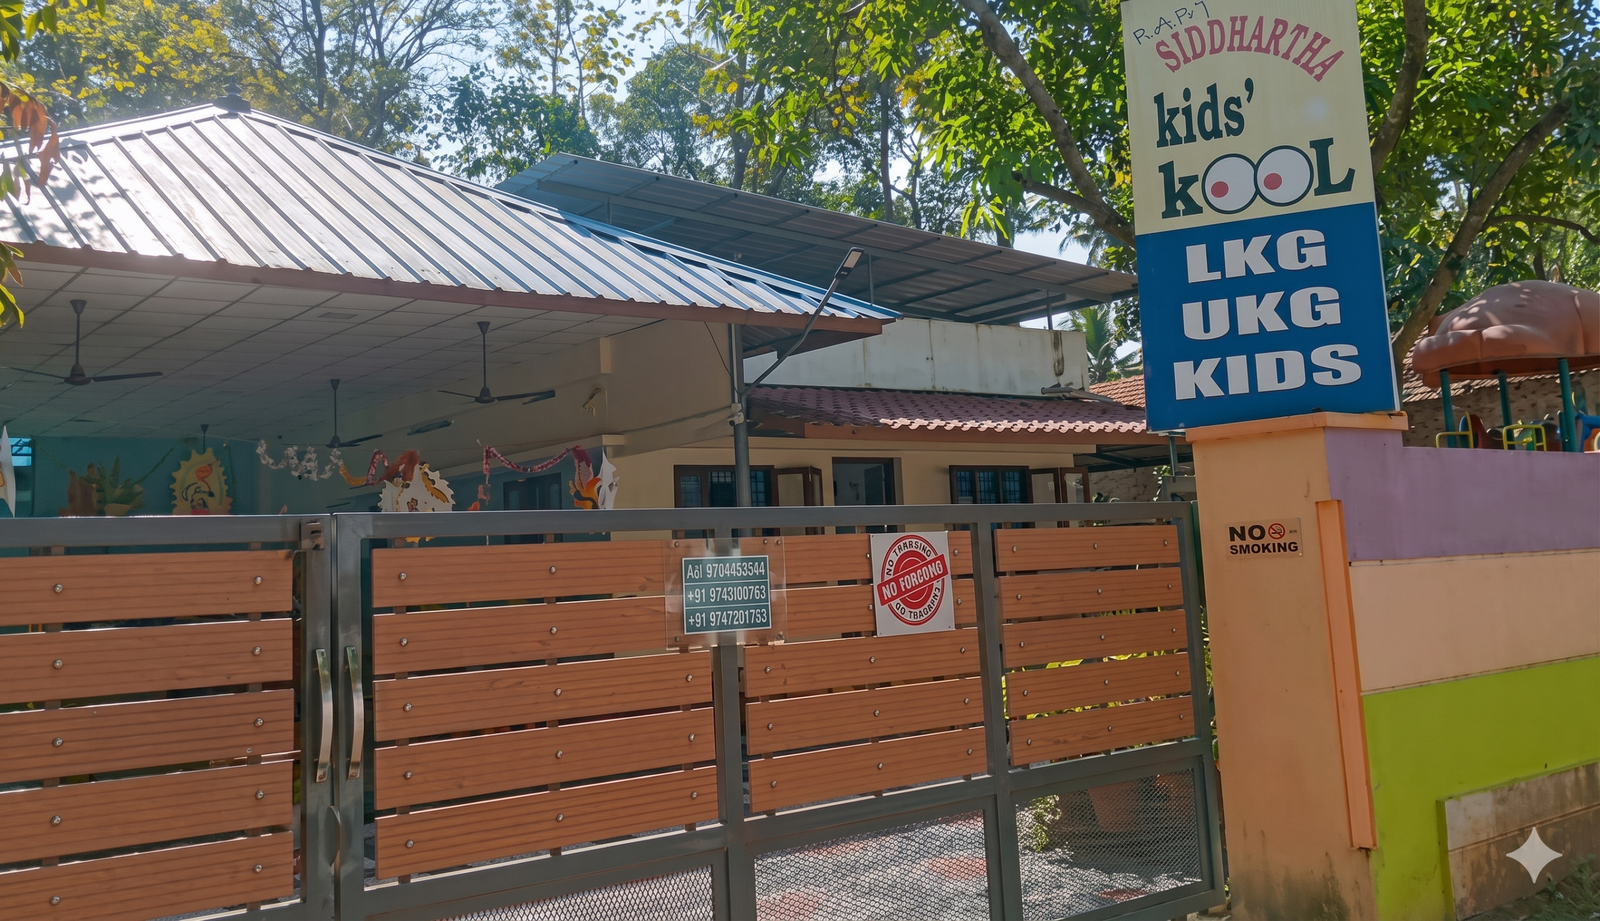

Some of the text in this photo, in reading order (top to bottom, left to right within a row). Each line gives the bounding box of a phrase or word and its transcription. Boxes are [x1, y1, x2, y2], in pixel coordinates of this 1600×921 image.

[1155, 15, 1345, 83] SIDDHARTHA
[1185, 229, 1328, 284] LKG
[1182, 286, 1342, 340] UKG
[1173, 343, 1362, 401] KIDS
[1228, 524, 1266, 542] NO
[1229, 541, 1299, 555] SMOKING
[687, 588, 706, 603] +91
[881, 560, 943, 601] NO FORCONG
[688, 612, 706, 628] +91
